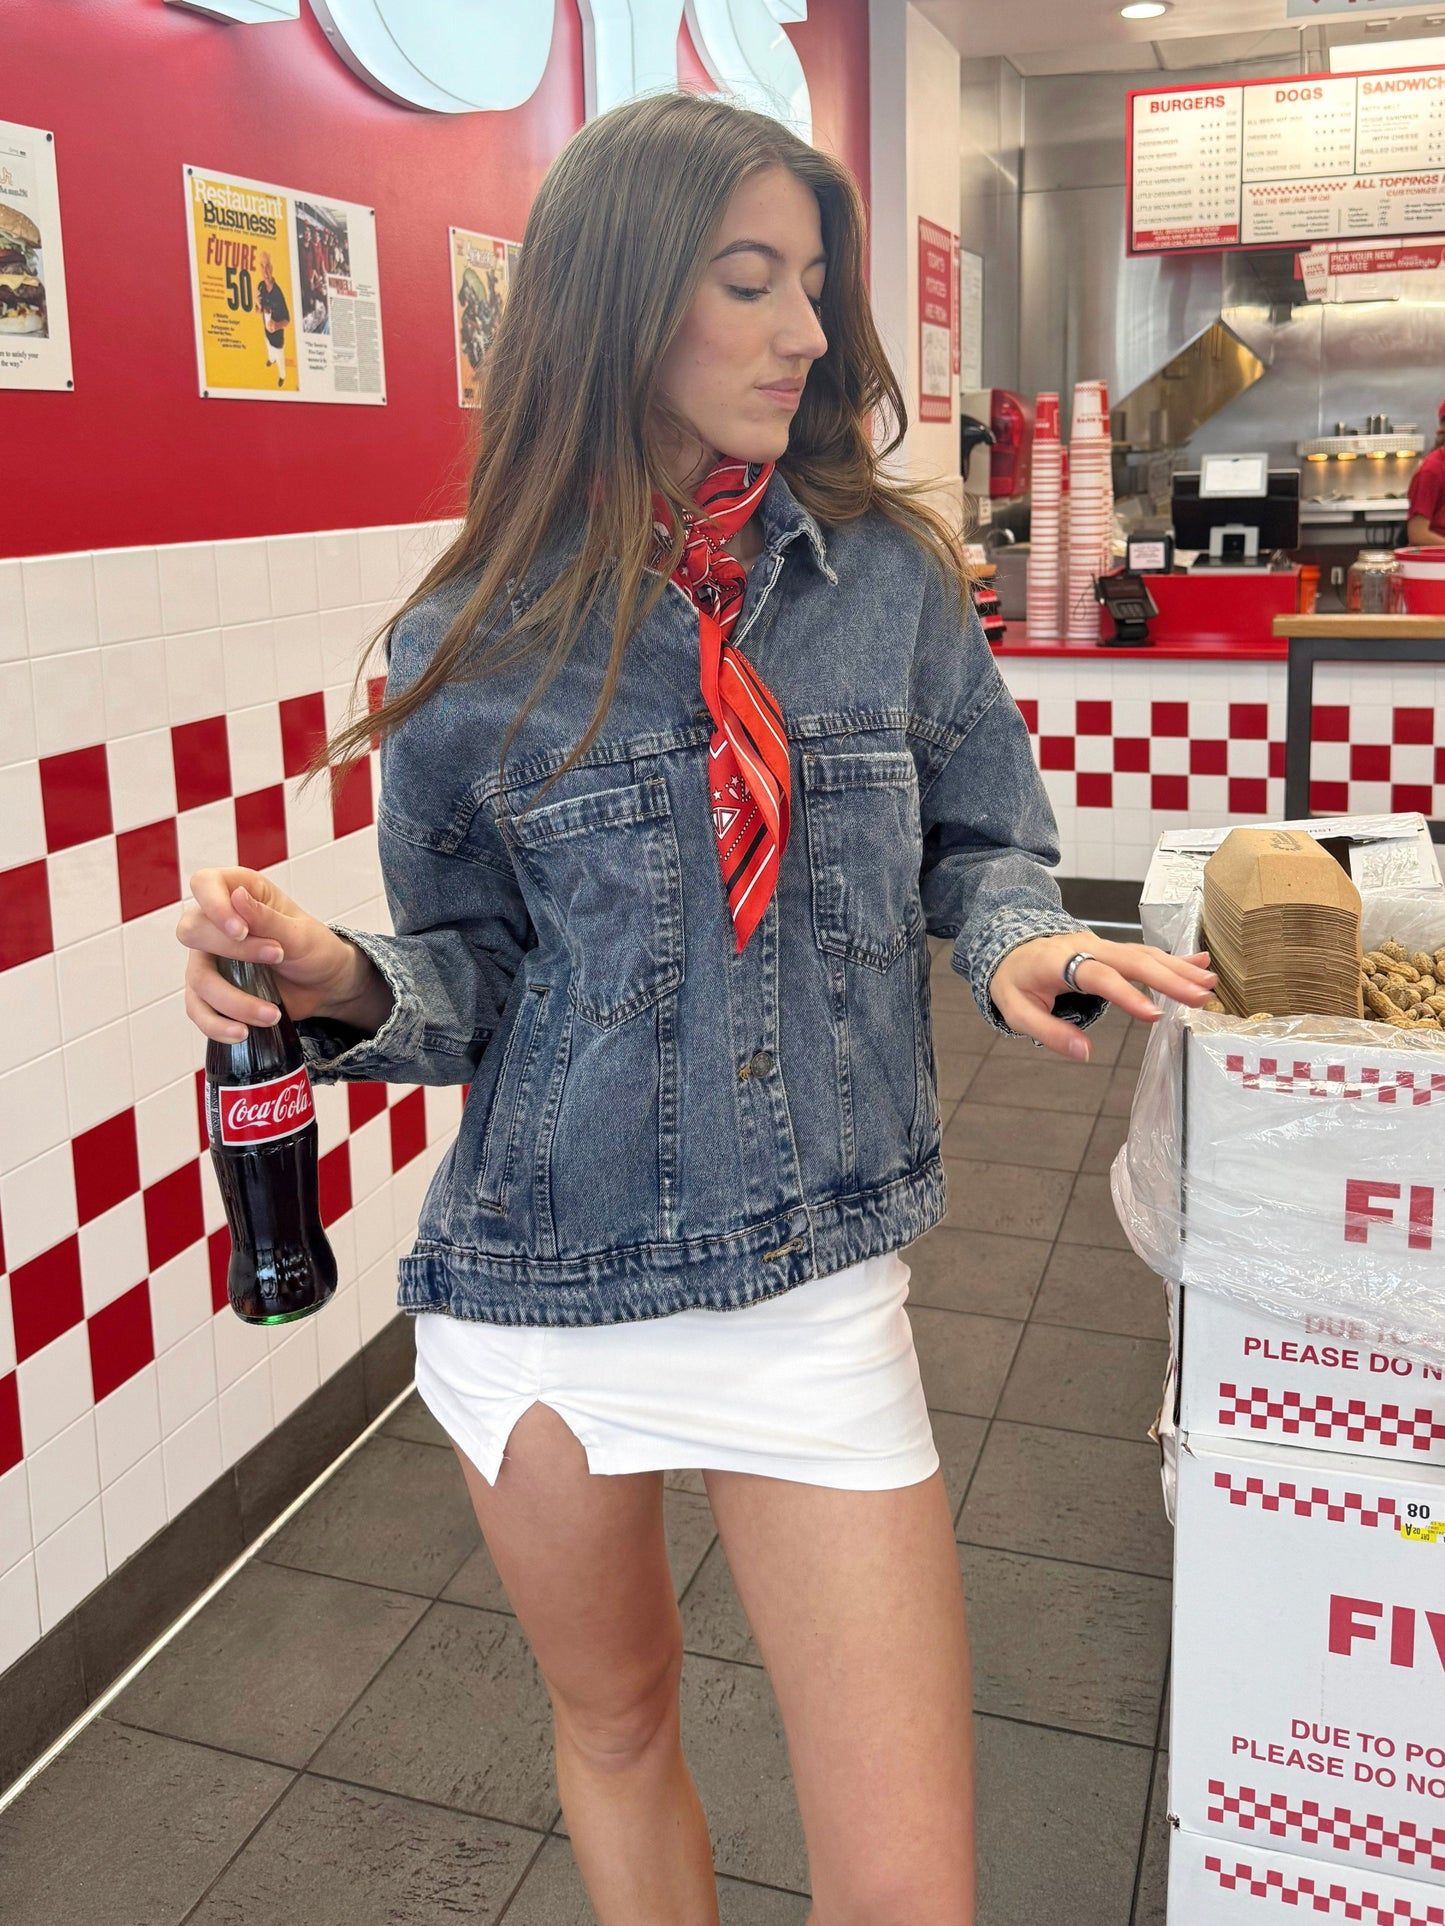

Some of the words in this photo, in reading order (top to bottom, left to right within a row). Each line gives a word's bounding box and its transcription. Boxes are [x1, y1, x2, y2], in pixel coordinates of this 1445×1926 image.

[1150, 95, 1225, 114] BURGERS
[1275, 87, 1323, 103] DOGS
[194, 179, 283, 219] Restaurant
[1353, 179, 1376, 189] ALL
[1379, 174, 1439, 188] TOPPINGS
[203, 198, 277, 236] Business
[206, 237, 257, 272] FUTURE
[1331, 253, 1350, 262] PICK
[1351, 252, 1373, 261] YOUR
[1374, 251, 1394, 260] NEW
[1331, 261, 1368, 273] FAVORITE
[226, 267, 253, 312] 50
[228, 1079, 308, 1130] Coca-Cola
[1344, 1179, 1445, 1250] FI
[1243, 1336, 1359, 1370] PLEASE
[1369, 1353, 1413, 1376] DO
[1405, 1522, 1412, 1536] A
[1407, 1503, 1430, 1519] 08
[1291, 1718, 1350, 1749] DUE
[1357, 1732, 1396, 1758] TO
[1405, 1742, 1445, 1768] PO
[1231, 1735, 1344, 1778] PLEASE
[1354, 1762, 1396, 1788] DO
[1406, 1773, 1445, 1799] NO
